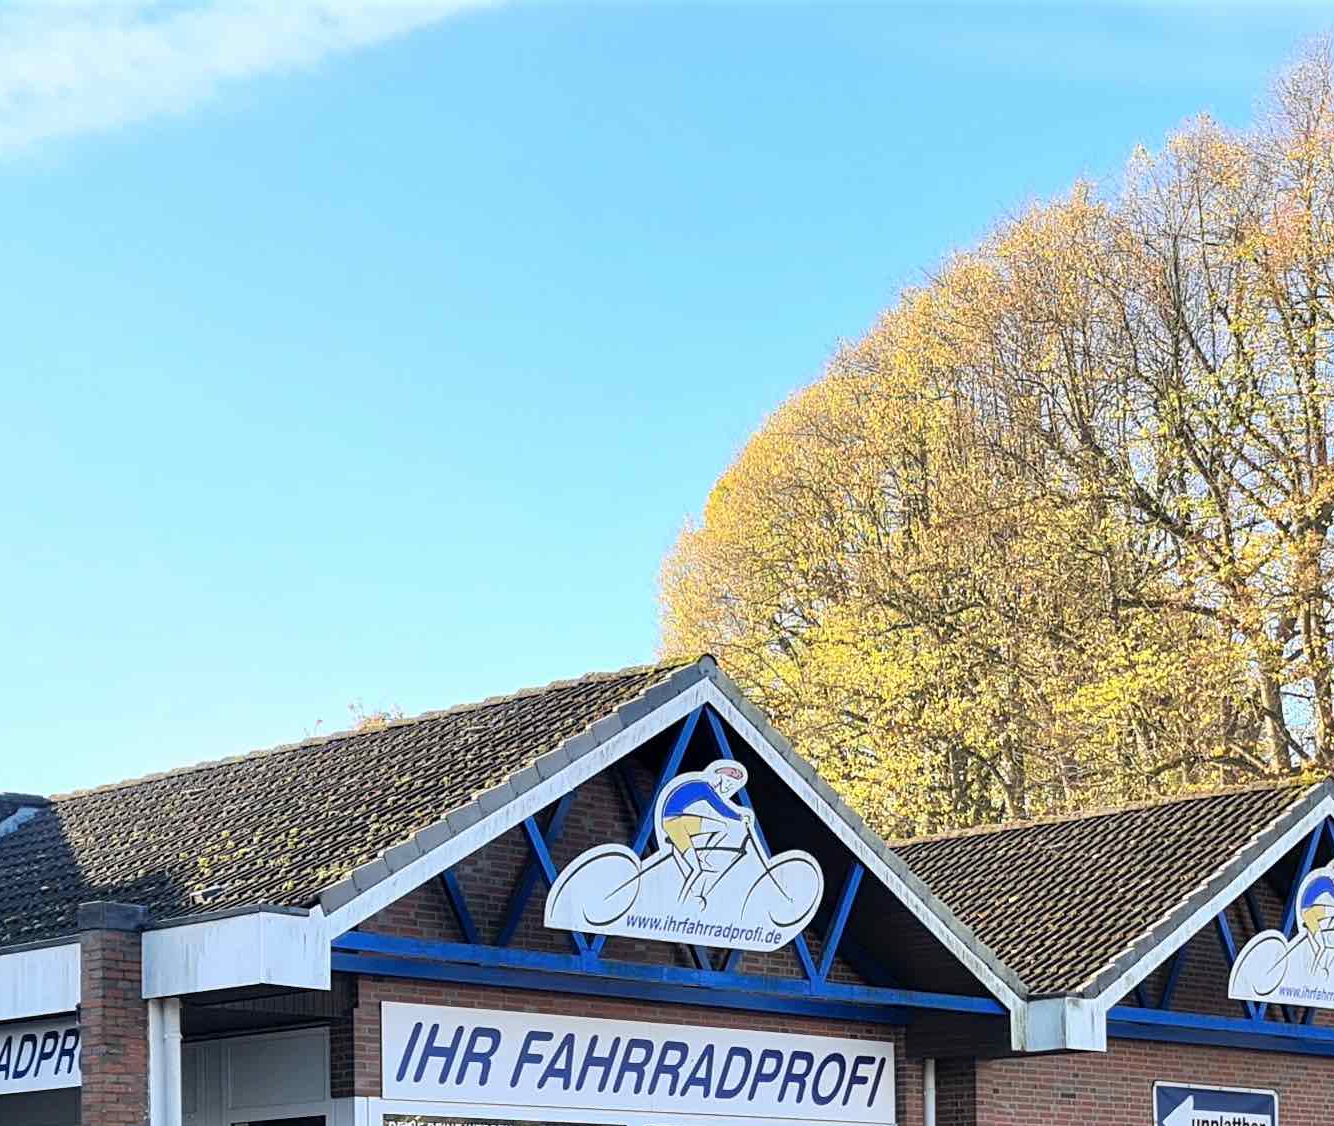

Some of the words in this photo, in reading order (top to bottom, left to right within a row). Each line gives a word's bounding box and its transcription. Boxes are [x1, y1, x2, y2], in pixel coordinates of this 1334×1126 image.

[626, 913, 782, 946] www.ihrfahrradprofi.de
[395, 1021, 501, 1086] IHR
[510, 1029, 886, 1108] FAHRRADPROFI
